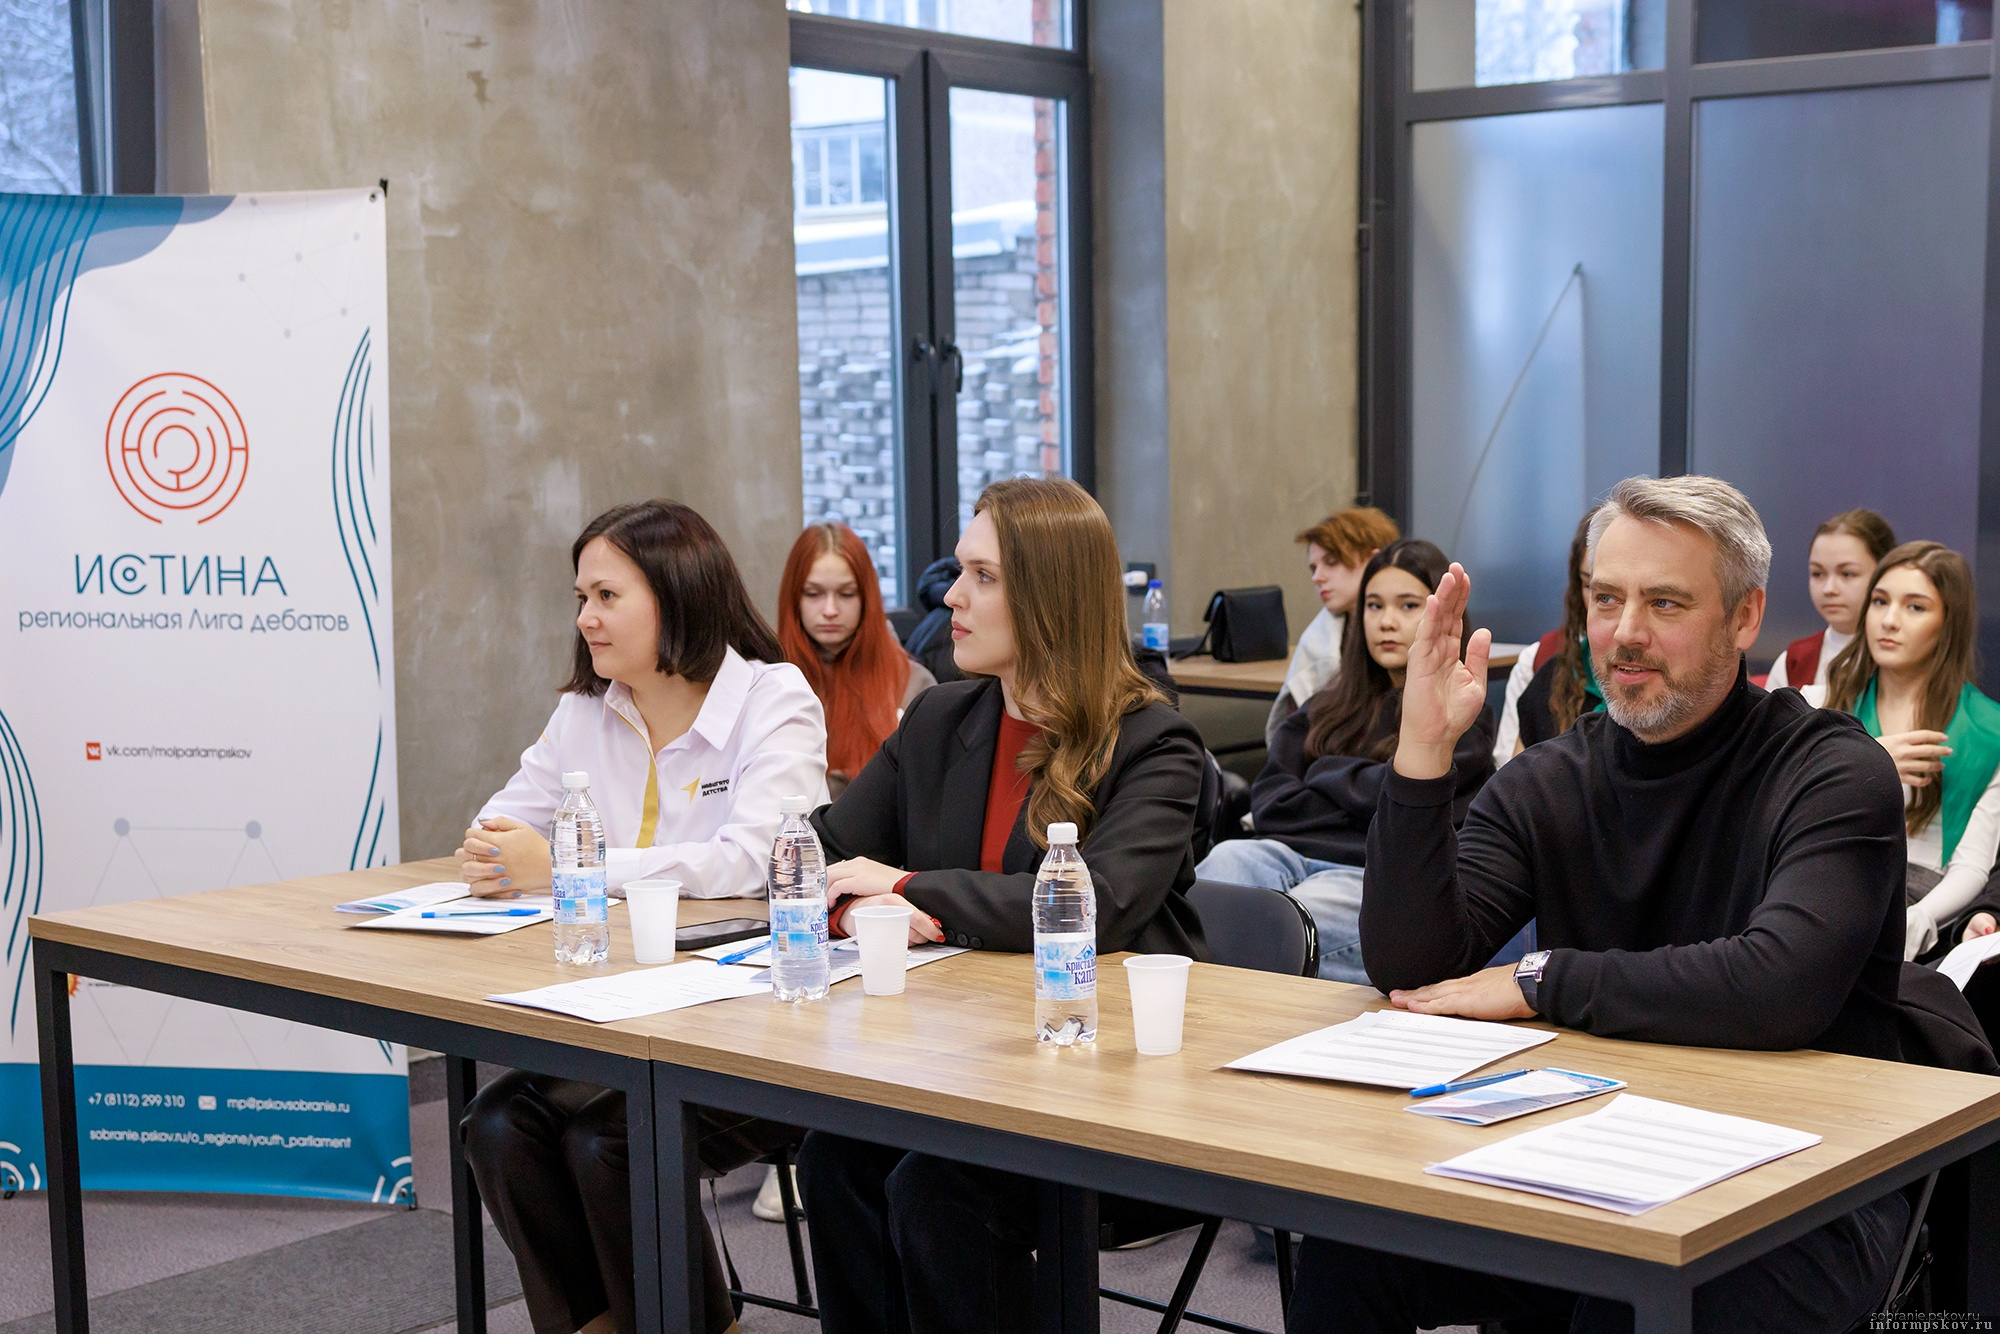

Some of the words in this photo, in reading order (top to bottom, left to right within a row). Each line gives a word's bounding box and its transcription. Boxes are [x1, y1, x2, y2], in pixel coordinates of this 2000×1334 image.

[75, 554, 287, 596] ИСТИНА
[19, 611, 182, 632] региональная
[189, 608, 243, 630] Лига
[250, 608, 350, 633] дебатов
[88, 1093, 101, 1106] +7
[104, 1093, 140, 1107] (8112)
[142, 1094, 163, 1107] 299
[164, 1094, 186, 1108] 310
[226, 1096, 350, 1114] mp@pskovsobranie.ru
